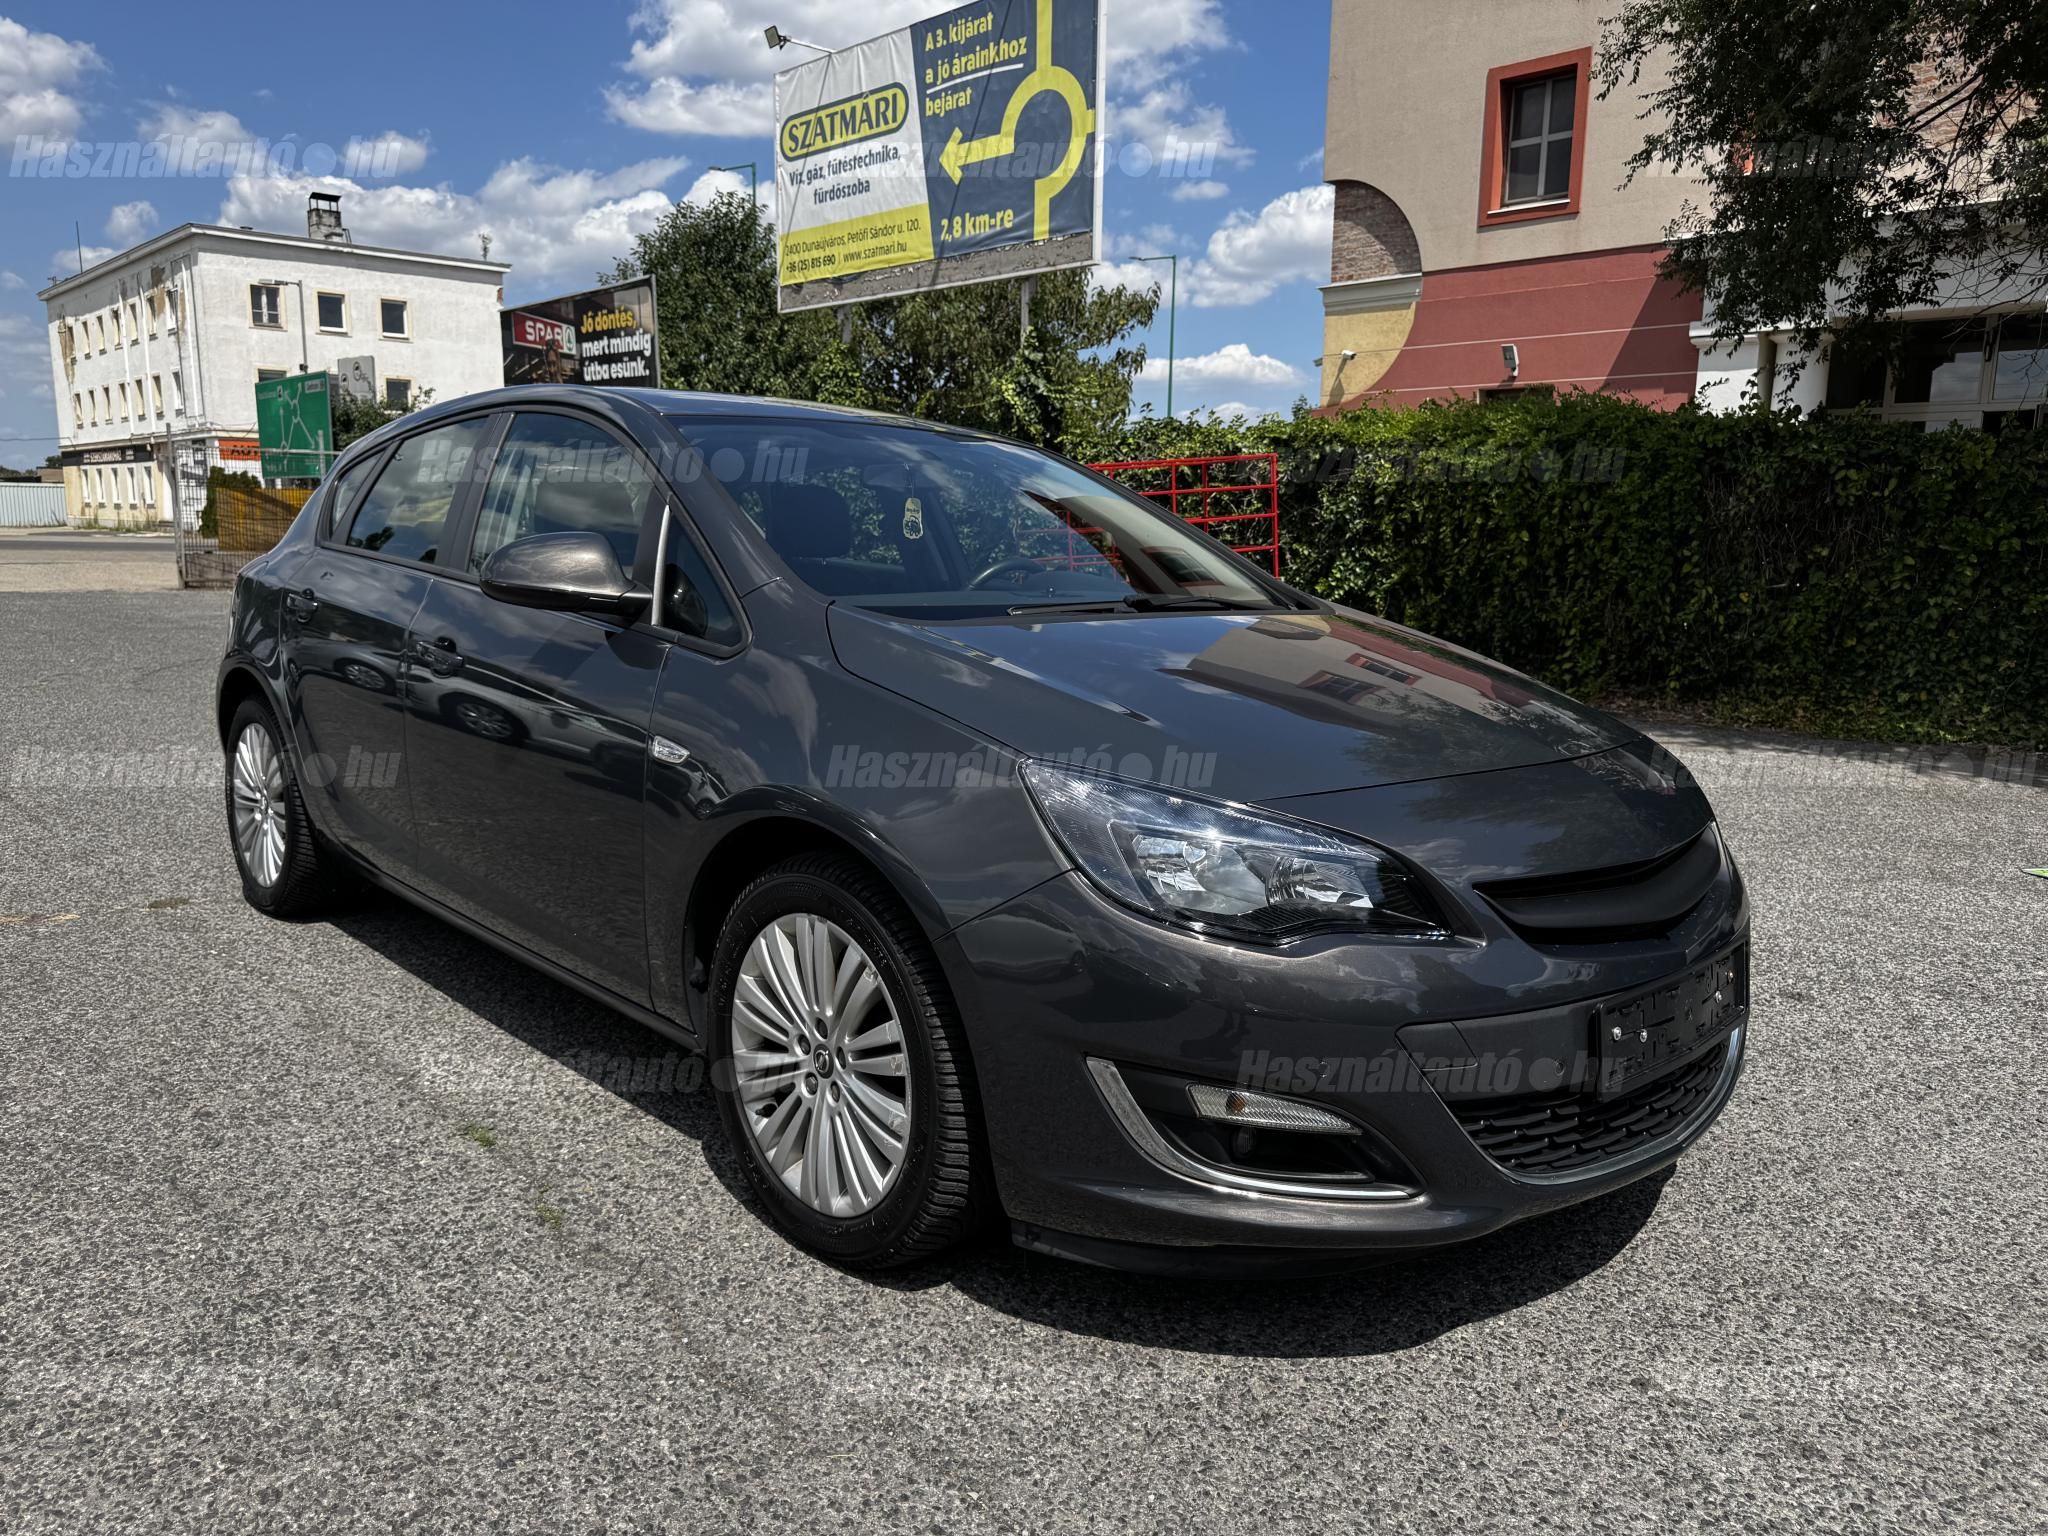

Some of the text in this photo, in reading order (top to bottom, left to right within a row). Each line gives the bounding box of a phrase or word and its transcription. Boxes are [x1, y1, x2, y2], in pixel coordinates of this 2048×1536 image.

[925, 11, 994, 51] A 3. kijárat
[925, 36, 1027, 85] a jó árainkhoz
[925, 86, 972, 118] bejárat
[788, 91, 898, 153] SZATMÁRI
[807, 163, 826, 186] gáz,
[813, 178, 871, 205] fürdőszoba
[785, 241, 801, 256] 2400
[869, 226, 896, 240] Sándor
[897, 224, 905, 234] u.
[906, 218, 921, 232] 120.
[940, 208, 1014, 242] 2,8 km-re
[798, 259, 810, 272] (25)
[842, 241, 908, 263] www.szatmari.hu
[525, 320, 563, 344] SPAR
[580, 304, 637, 334] Jó döntés,
[582, 328, 652, 358] mert mindig
[583, 356, 650, 382] útba esünk.
